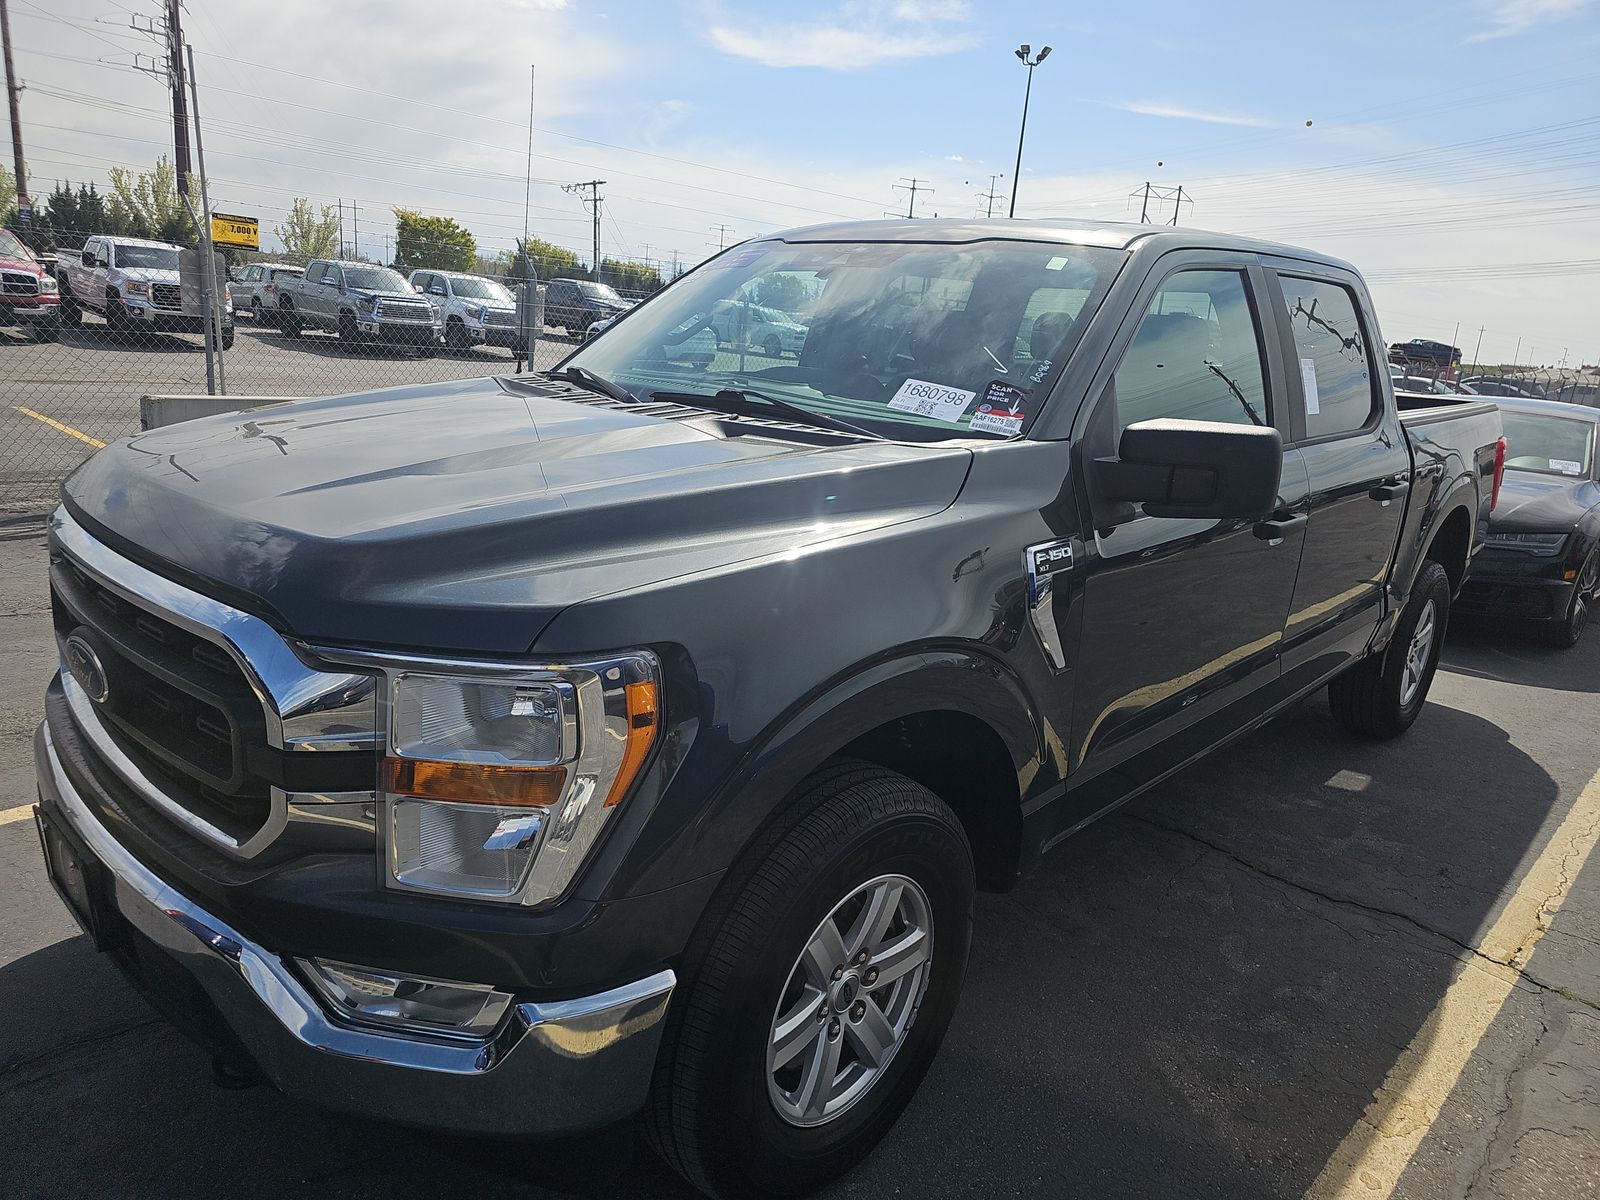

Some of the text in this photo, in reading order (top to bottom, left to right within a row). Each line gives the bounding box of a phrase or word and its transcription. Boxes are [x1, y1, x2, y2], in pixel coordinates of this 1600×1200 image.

[991, 383, 1013, 393] SCAN
[903, 383, 967, 406] 1680798
[986, 395, 1010, 403] PRICE
[974, 414, 1005, 425] AAF16275
[1036, 547, 1071, 565] F-150
[1039, 564, 1050, 573] XLT
